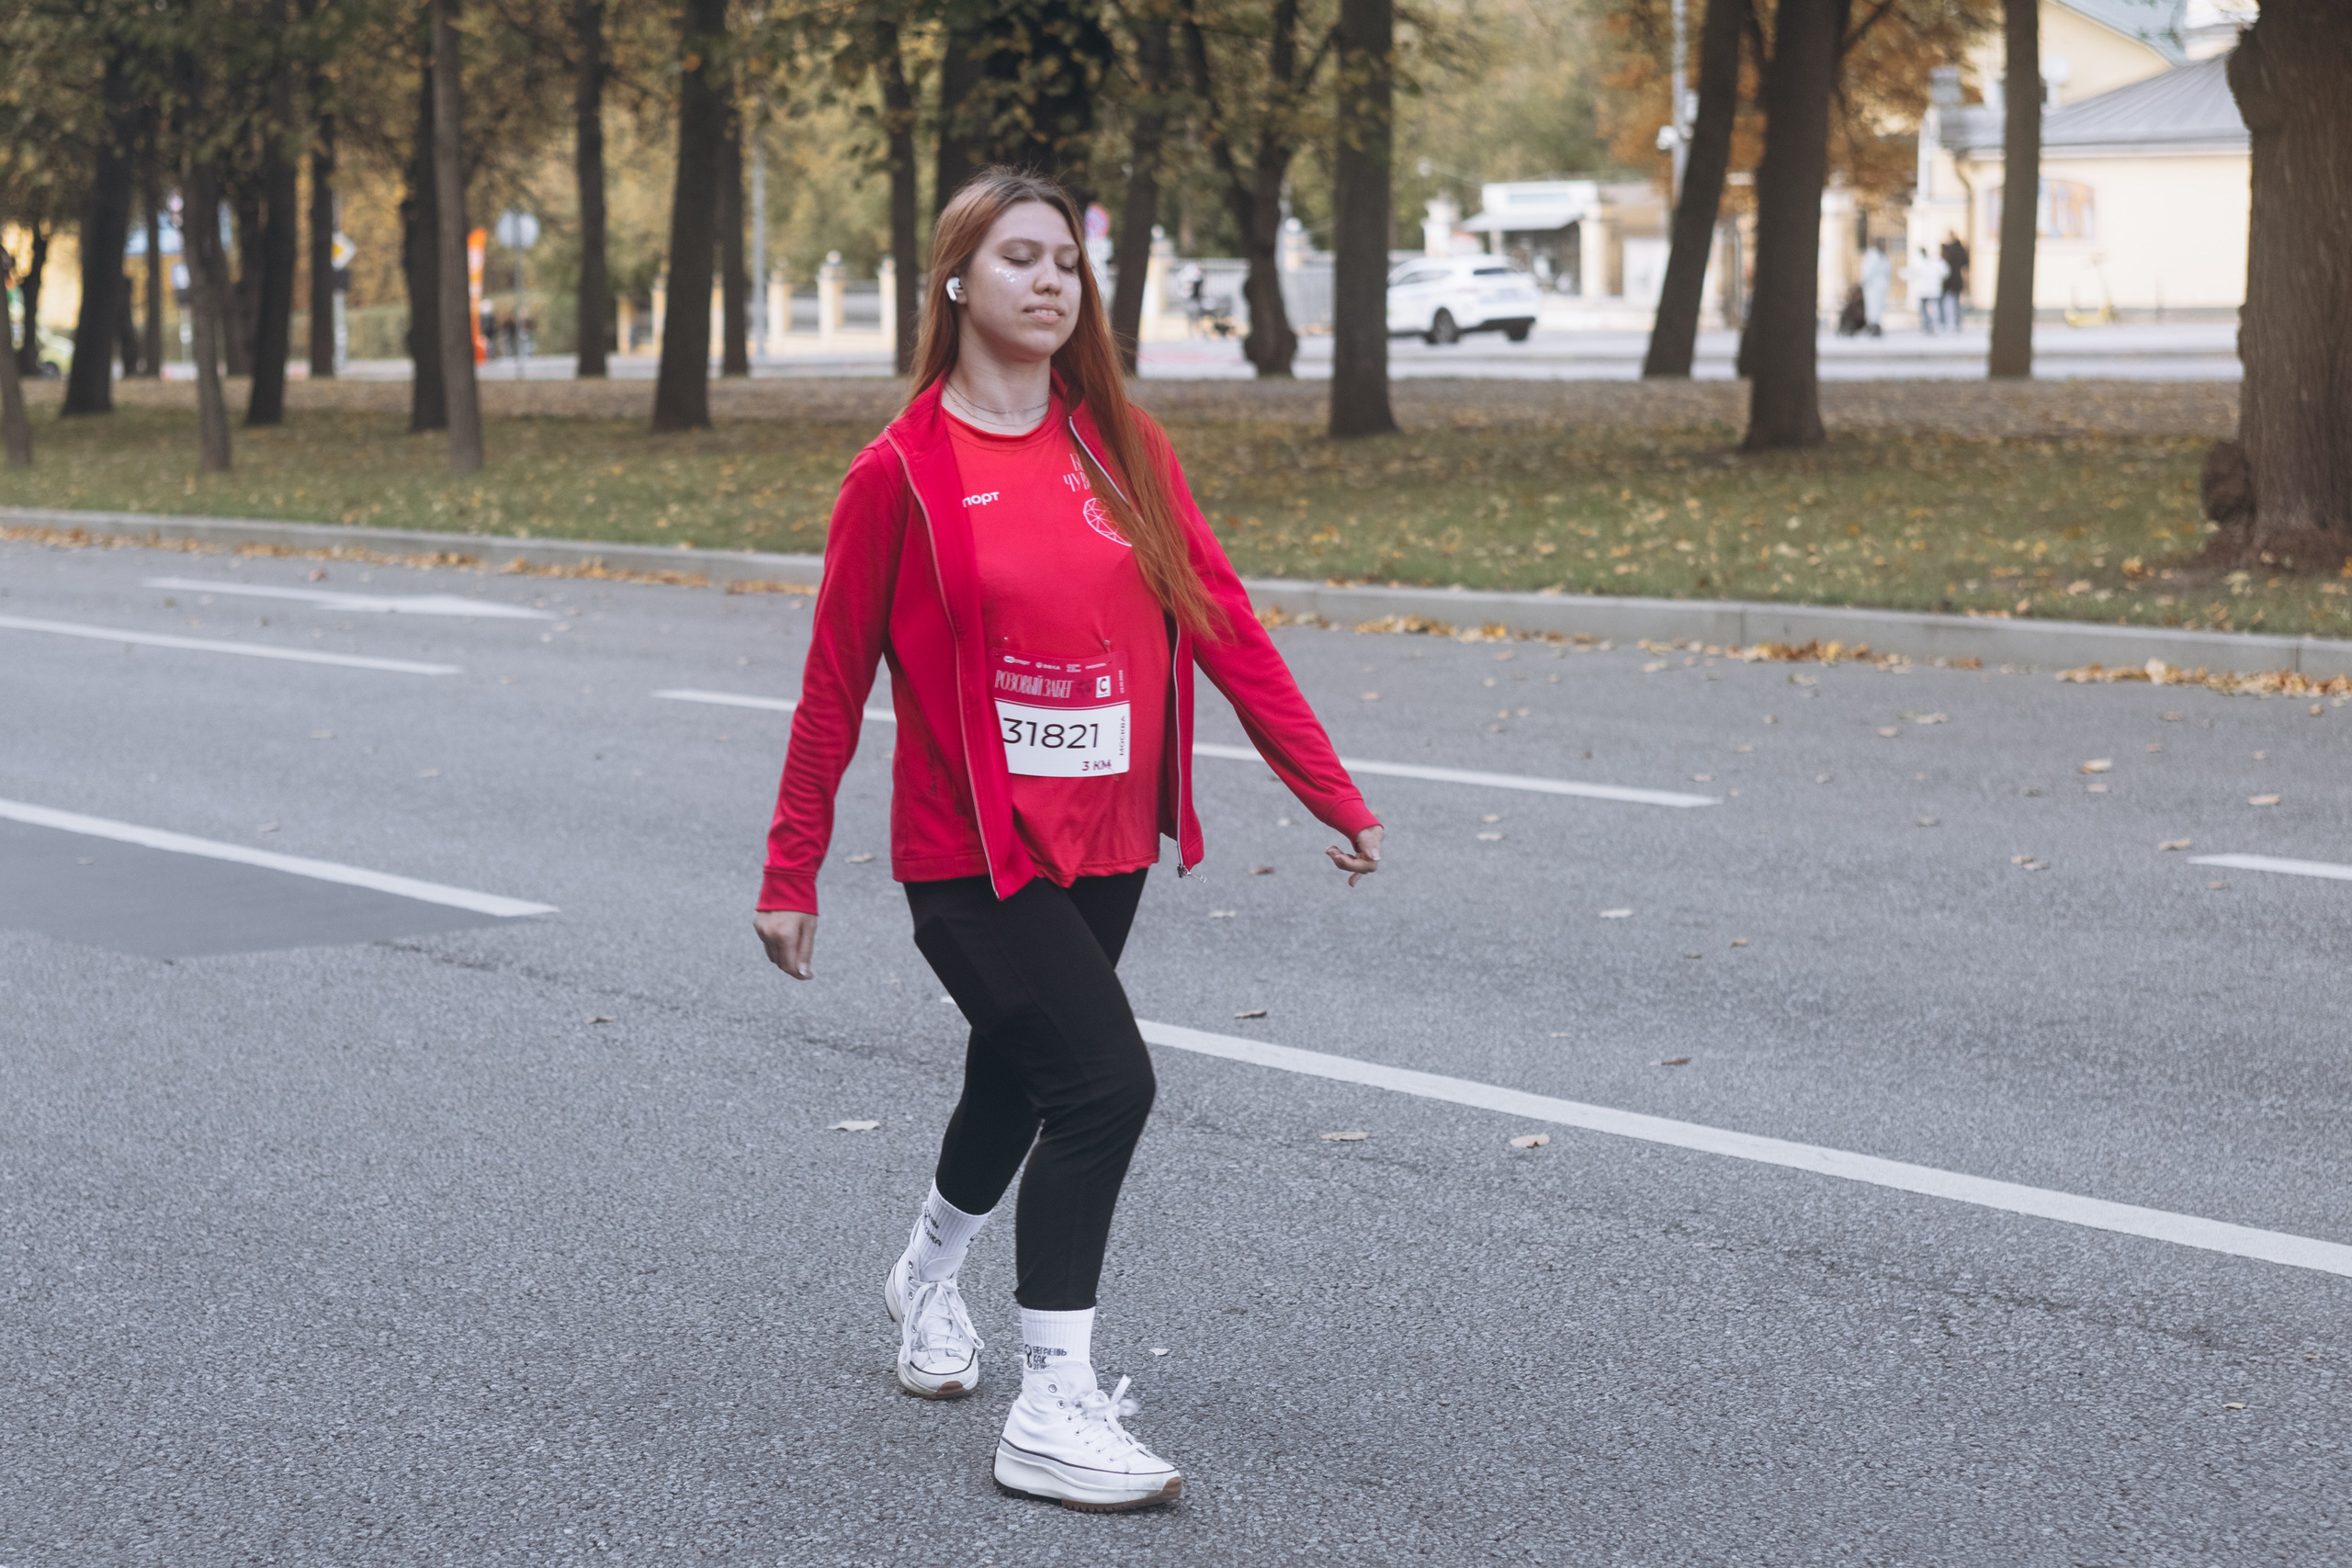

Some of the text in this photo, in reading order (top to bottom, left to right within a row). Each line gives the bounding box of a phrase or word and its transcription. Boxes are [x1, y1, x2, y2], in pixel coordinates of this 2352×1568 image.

[994, 670, 1043, 696] РОЗОВЫЙ
[1002, 716, 1098, 749] 31821
[1081, 761, 1090, 772] 3
